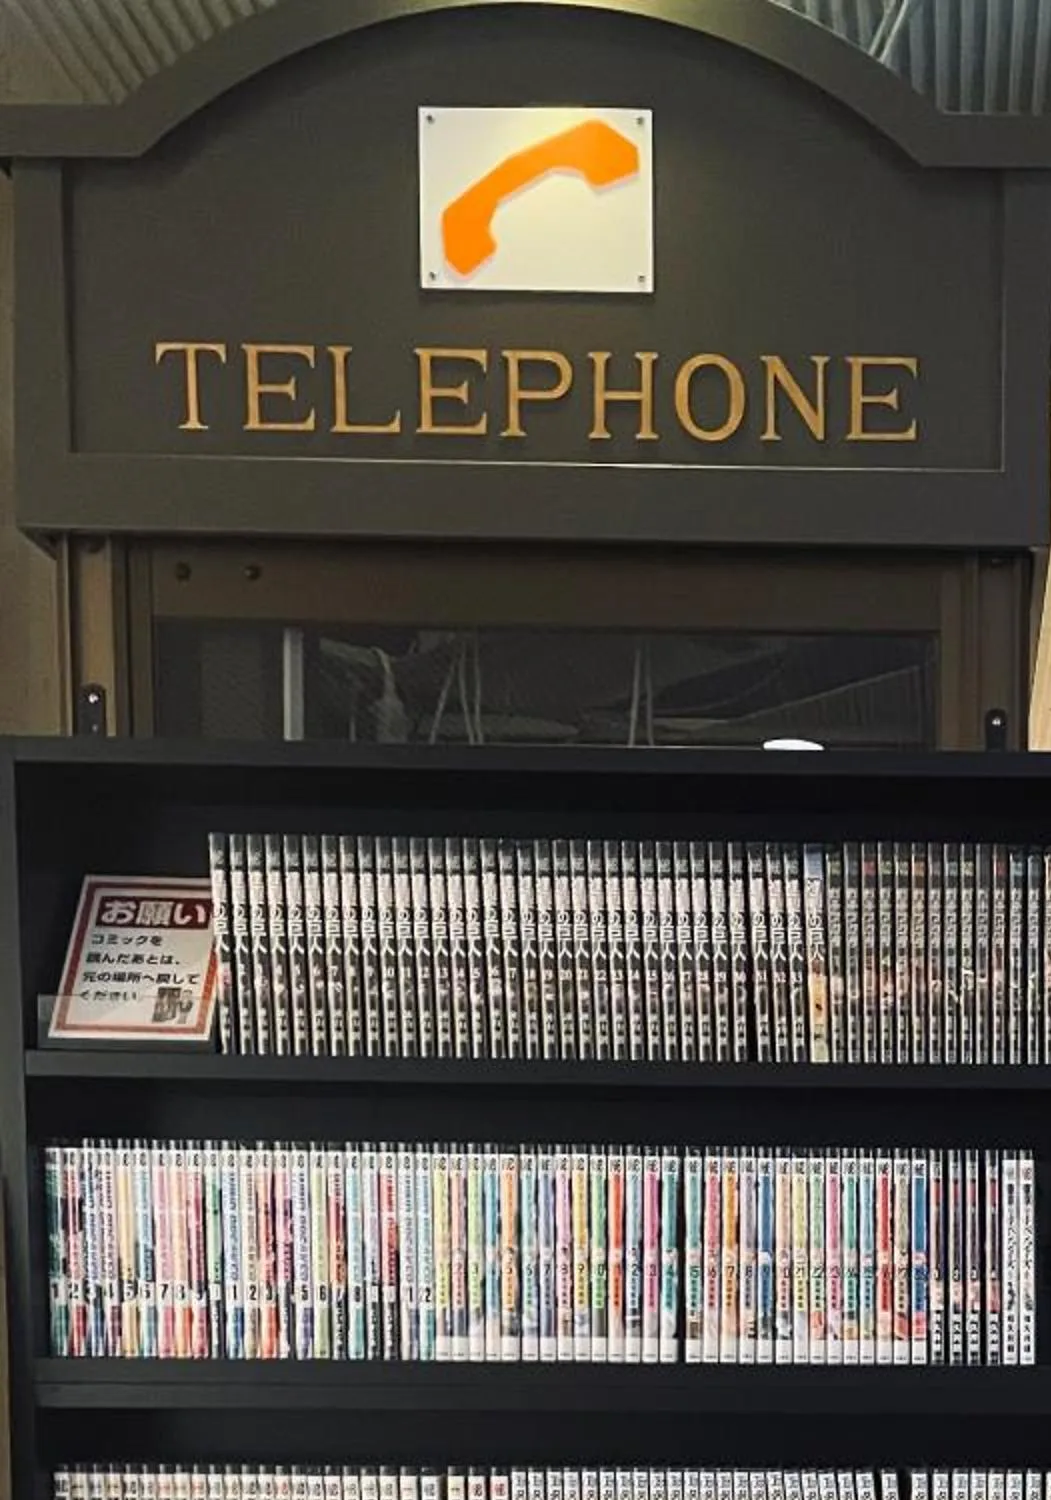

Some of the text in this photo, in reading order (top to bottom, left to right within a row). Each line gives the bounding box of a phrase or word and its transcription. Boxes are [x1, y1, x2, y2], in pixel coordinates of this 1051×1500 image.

[154, 341, 919, 442] TELEPHONE
[101, 900, 206, 925] お願い
[90, 935, 162, 945] コミックを
